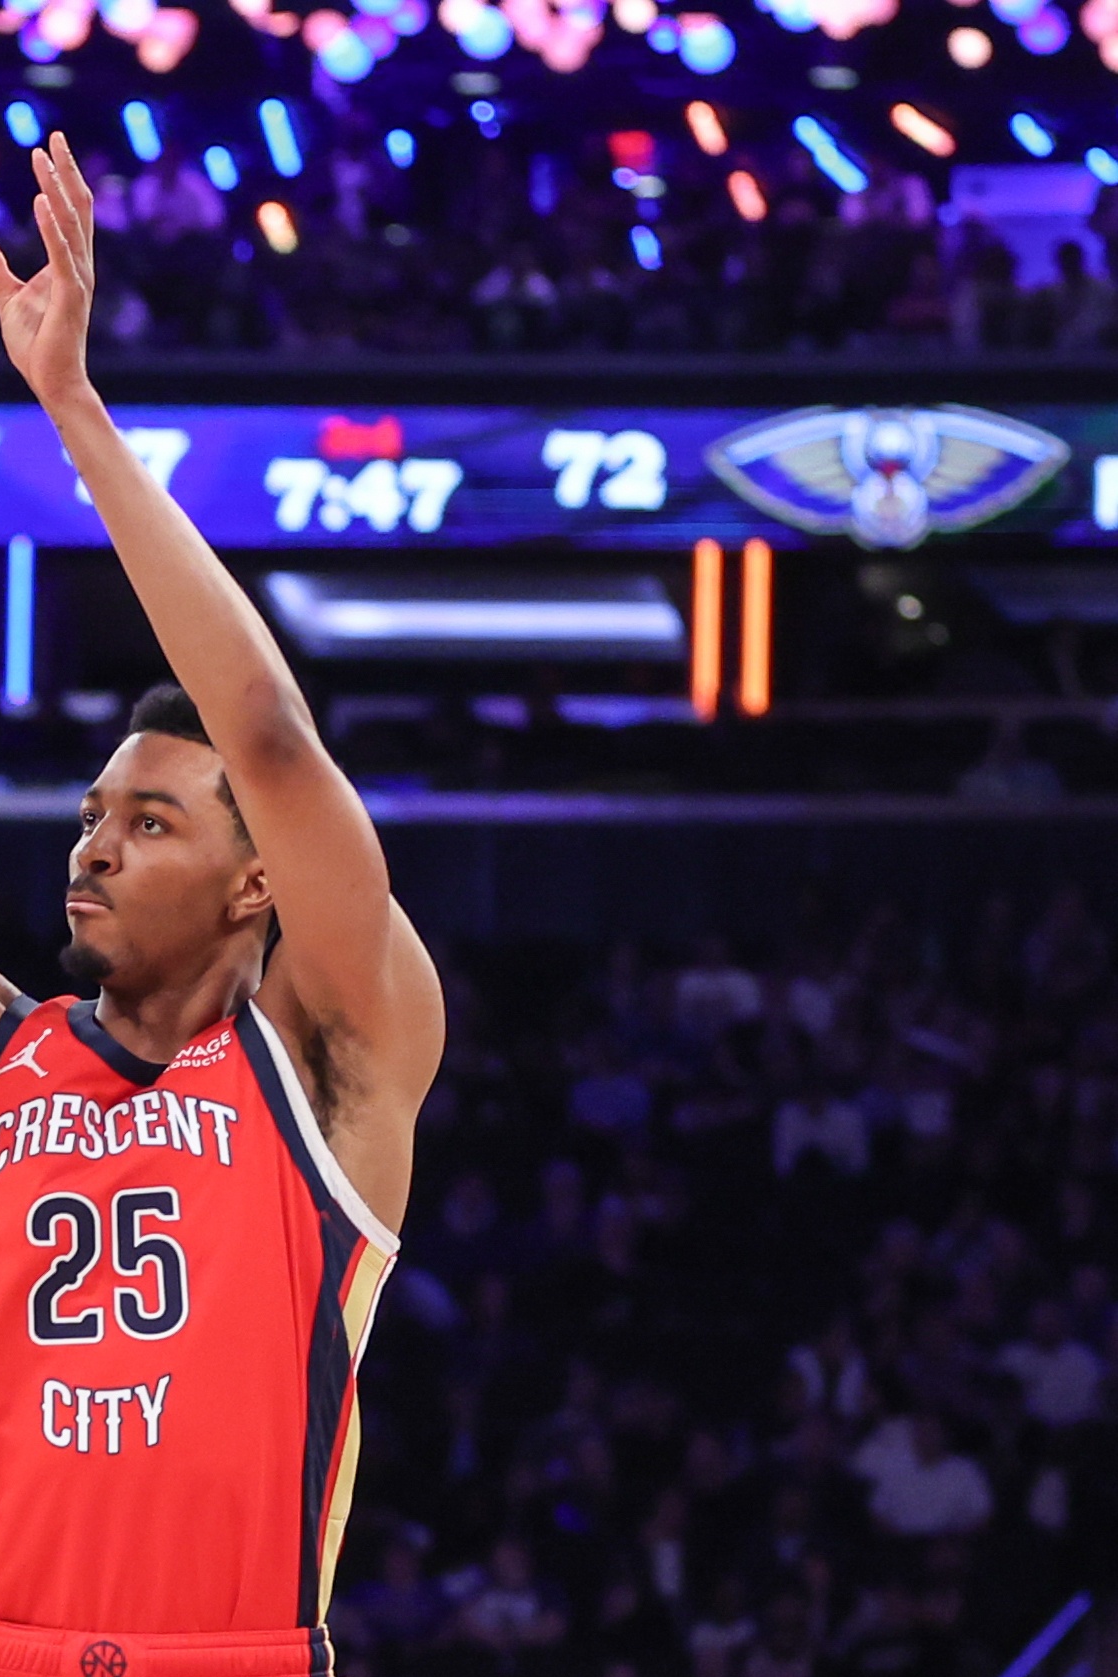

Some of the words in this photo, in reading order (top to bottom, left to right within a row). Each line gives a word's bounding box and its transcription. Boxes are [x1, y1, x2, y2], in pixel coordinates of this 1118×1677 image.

[264, 458, 464, 533] 7:47
[542, 429, 667, 510] 72
[25, 1185, 189, 1346] 25
[41, 1373, 172, 1455] CITY
